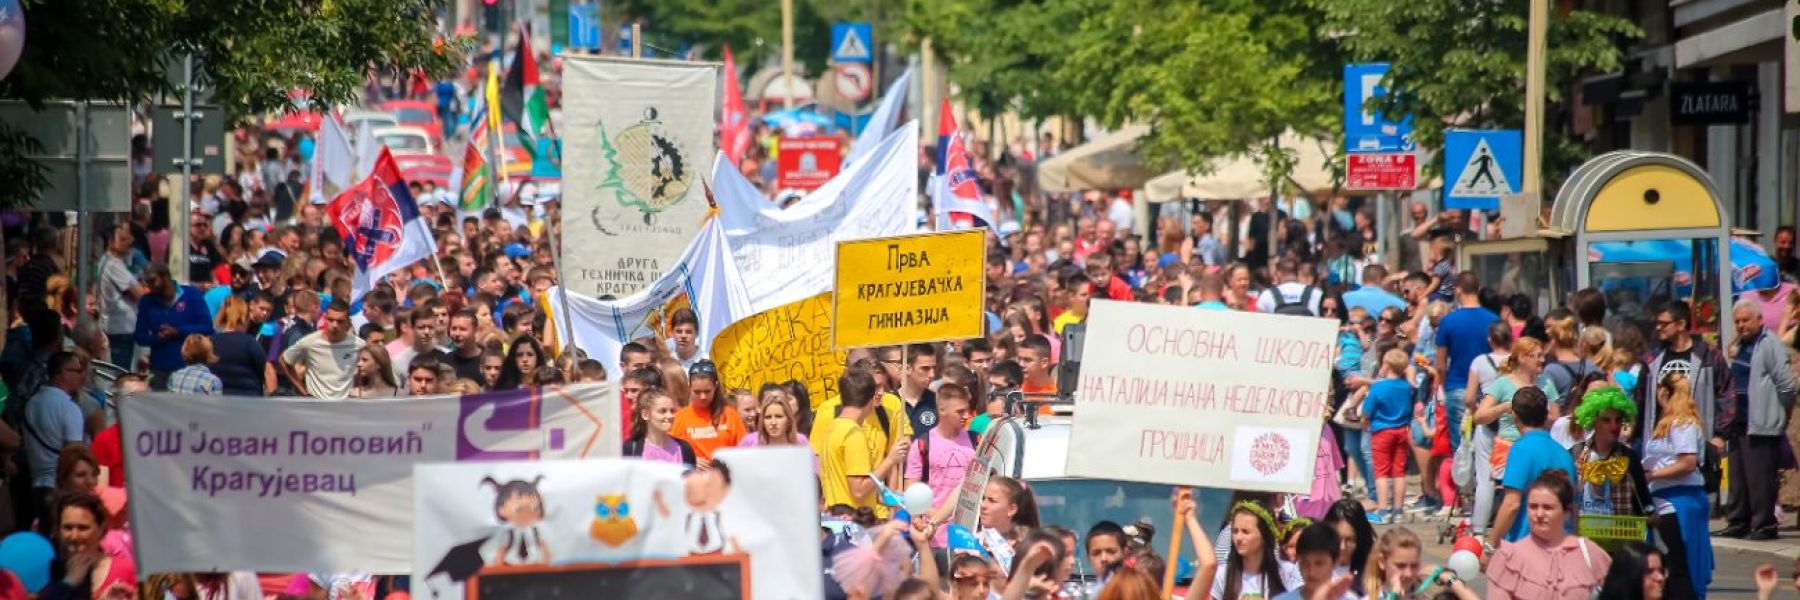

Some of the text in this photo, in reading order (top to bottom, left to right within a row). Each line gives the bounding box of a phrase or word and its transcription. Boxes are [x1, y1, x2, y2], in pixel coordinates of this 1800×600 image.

[1680, 93, 1738, 115] ZLATARA
[581, 269, 645, 282] ТЕХНИЧКА
[617, 257, 659, 270] ДРУГА
[857, 275, 963, 302] КРАГУЈЕВАЧКА
[1127, 323, 1331, 370] ОСНОВНА ШКОЛА
[1080, 374, 1168, 408] НАТАЛИЈА
[1173, 382, 1217, 410] НАНА
[136, 429, 182, 456] ОШ
[1138, 428, 1225, 465] ГРОШНИЦА
[192, 466, 356, 497] Крагујевац
